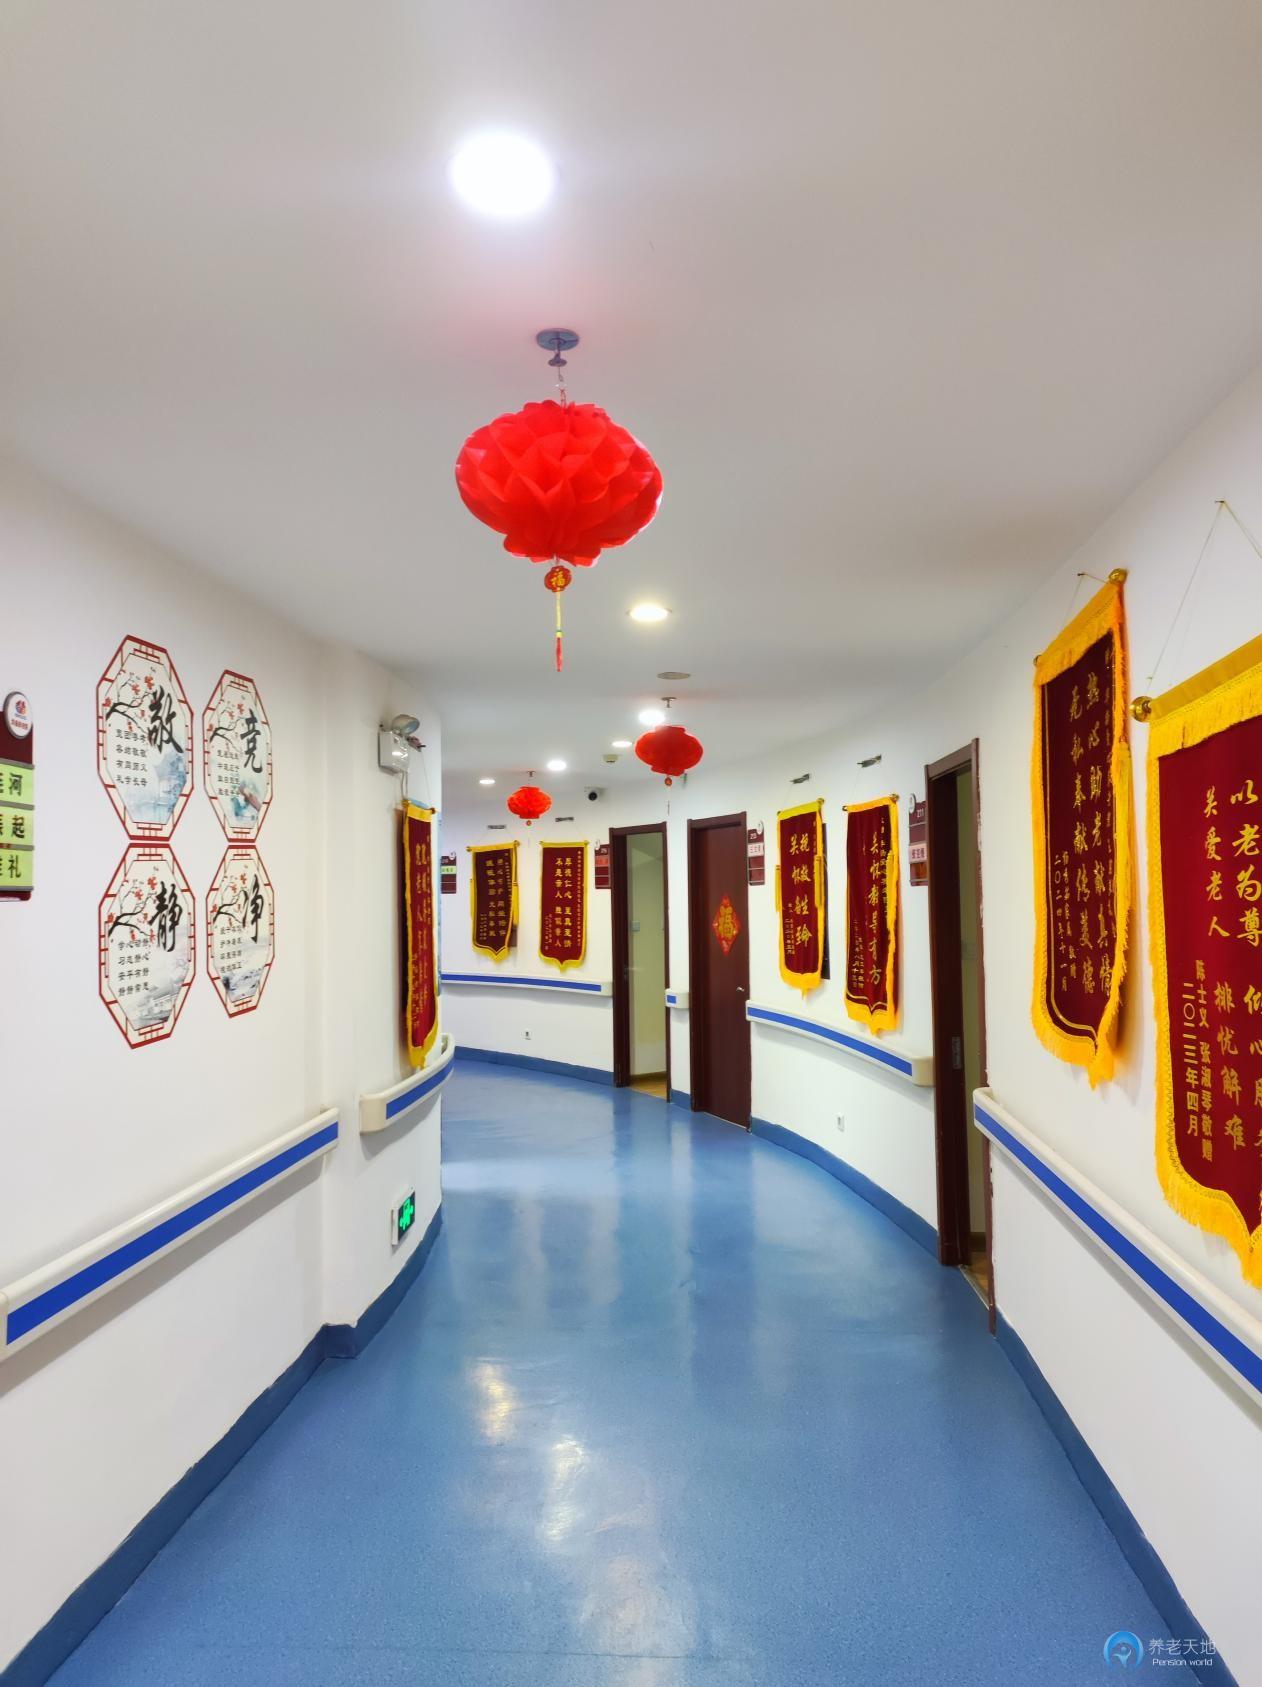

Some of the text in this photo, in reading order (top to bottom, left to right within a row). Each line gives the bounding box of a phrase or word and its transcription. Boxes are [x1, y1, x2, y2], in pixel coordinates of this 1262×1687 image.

[550, 570, 566, 586] 福
[147, 685, 184, 754] 敬
[147, 880, 183, 952] 静
[240, 873, 264, 944] 净
[1203, 785, 1231, 937] 关爱老人
[1230, 779, 1262, 947] 以老为尊
[1182, 982, 1200, 1137] 二〇二三年四月
[1214, 981, 1246, 1151] 排忧解难
